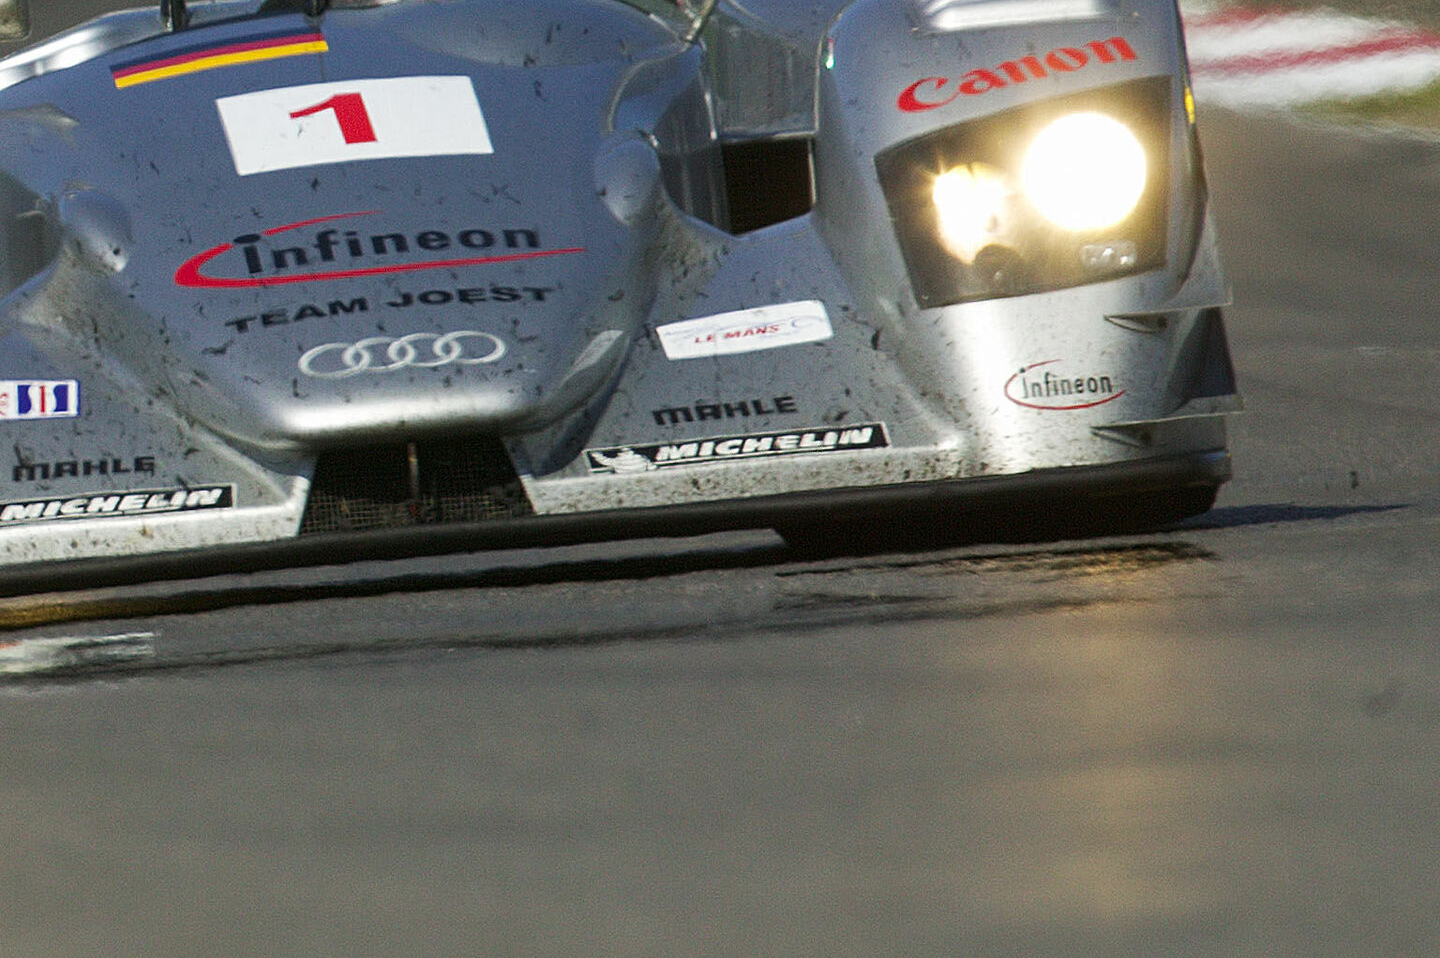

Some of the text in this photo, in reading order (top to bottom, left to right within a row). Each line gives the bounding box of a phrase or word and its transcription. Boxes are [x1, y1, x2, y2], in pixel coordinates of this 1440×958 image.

[896, 36, 1139, 112] Canon
[289, 92, 378, 145] 1
[225, 286, 555, 334] TEAM JOEST
[723, 324, 781, 339] MANS
[652, 396, 799, 426] MAHLE
[656, 427, 874, 461] MICHELIN
[13, 455, 157, 482] MAHLE
[0, 488, 224, 522] MICHELIN
